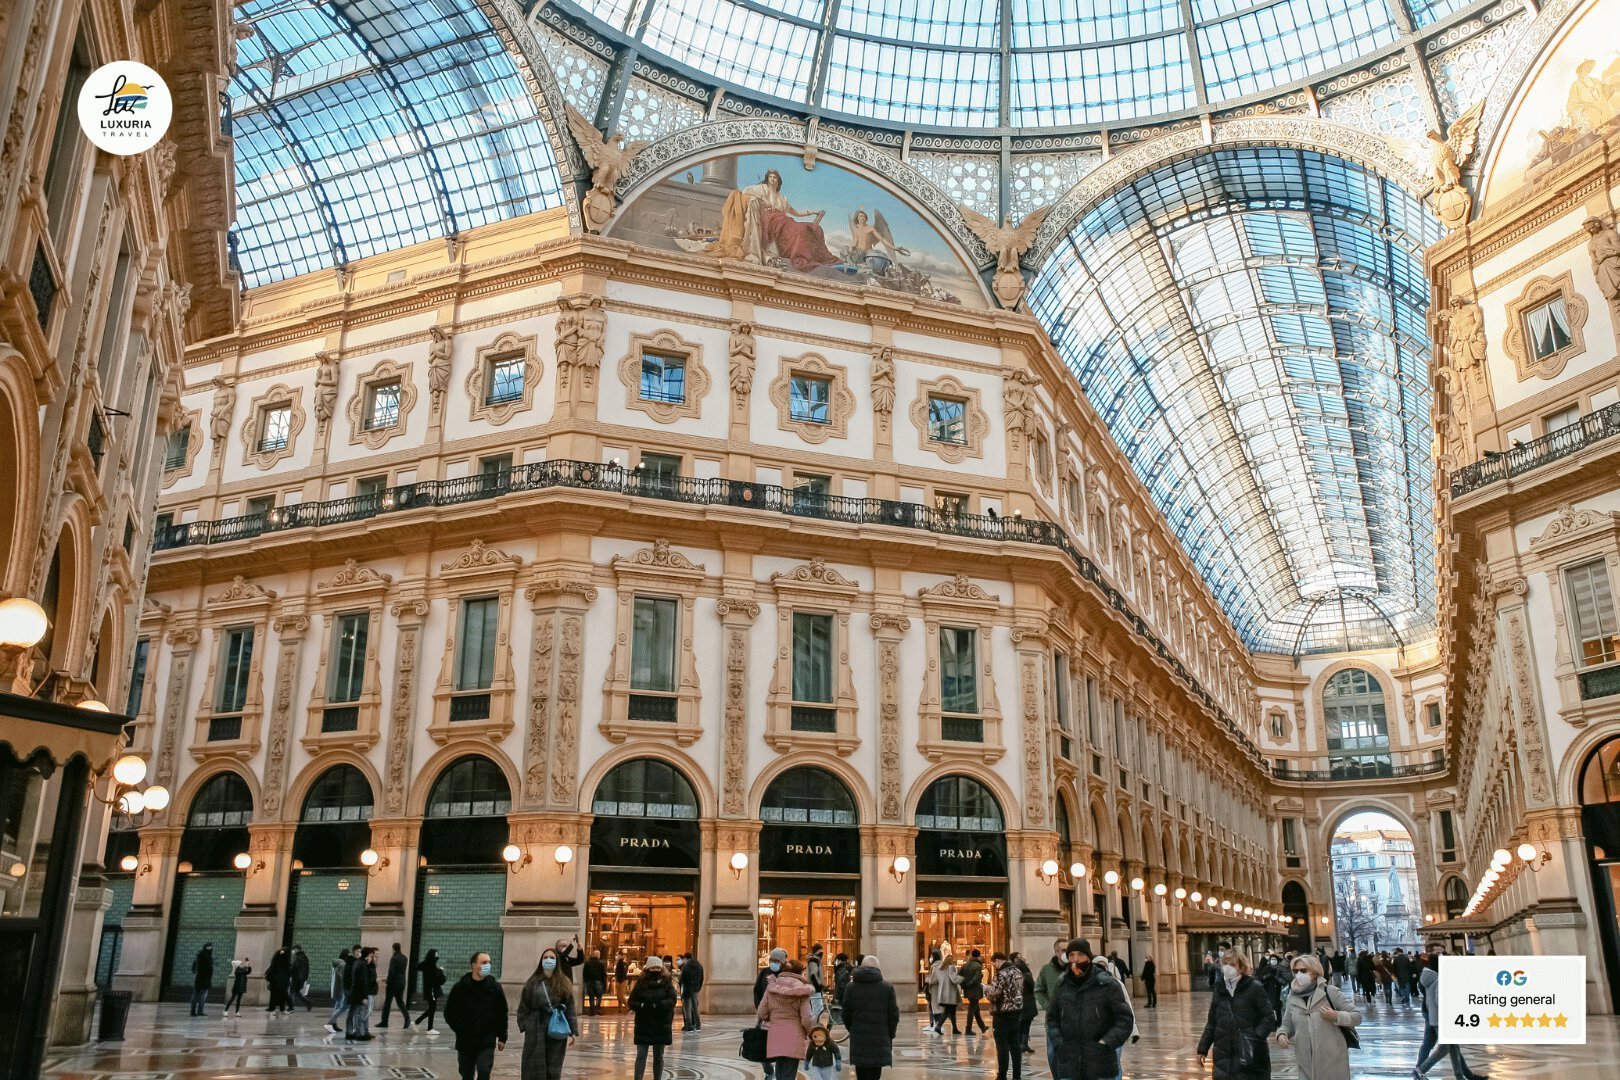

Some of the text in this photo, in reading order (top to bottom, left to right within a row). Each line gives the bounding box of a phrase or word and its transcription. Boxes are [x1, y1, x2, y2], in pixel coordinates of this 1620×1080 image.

[620, 837, 670, 848] PRADA
[786, 844, 833, 855] PRADA
[939, 849, 982, 859] PRADA
